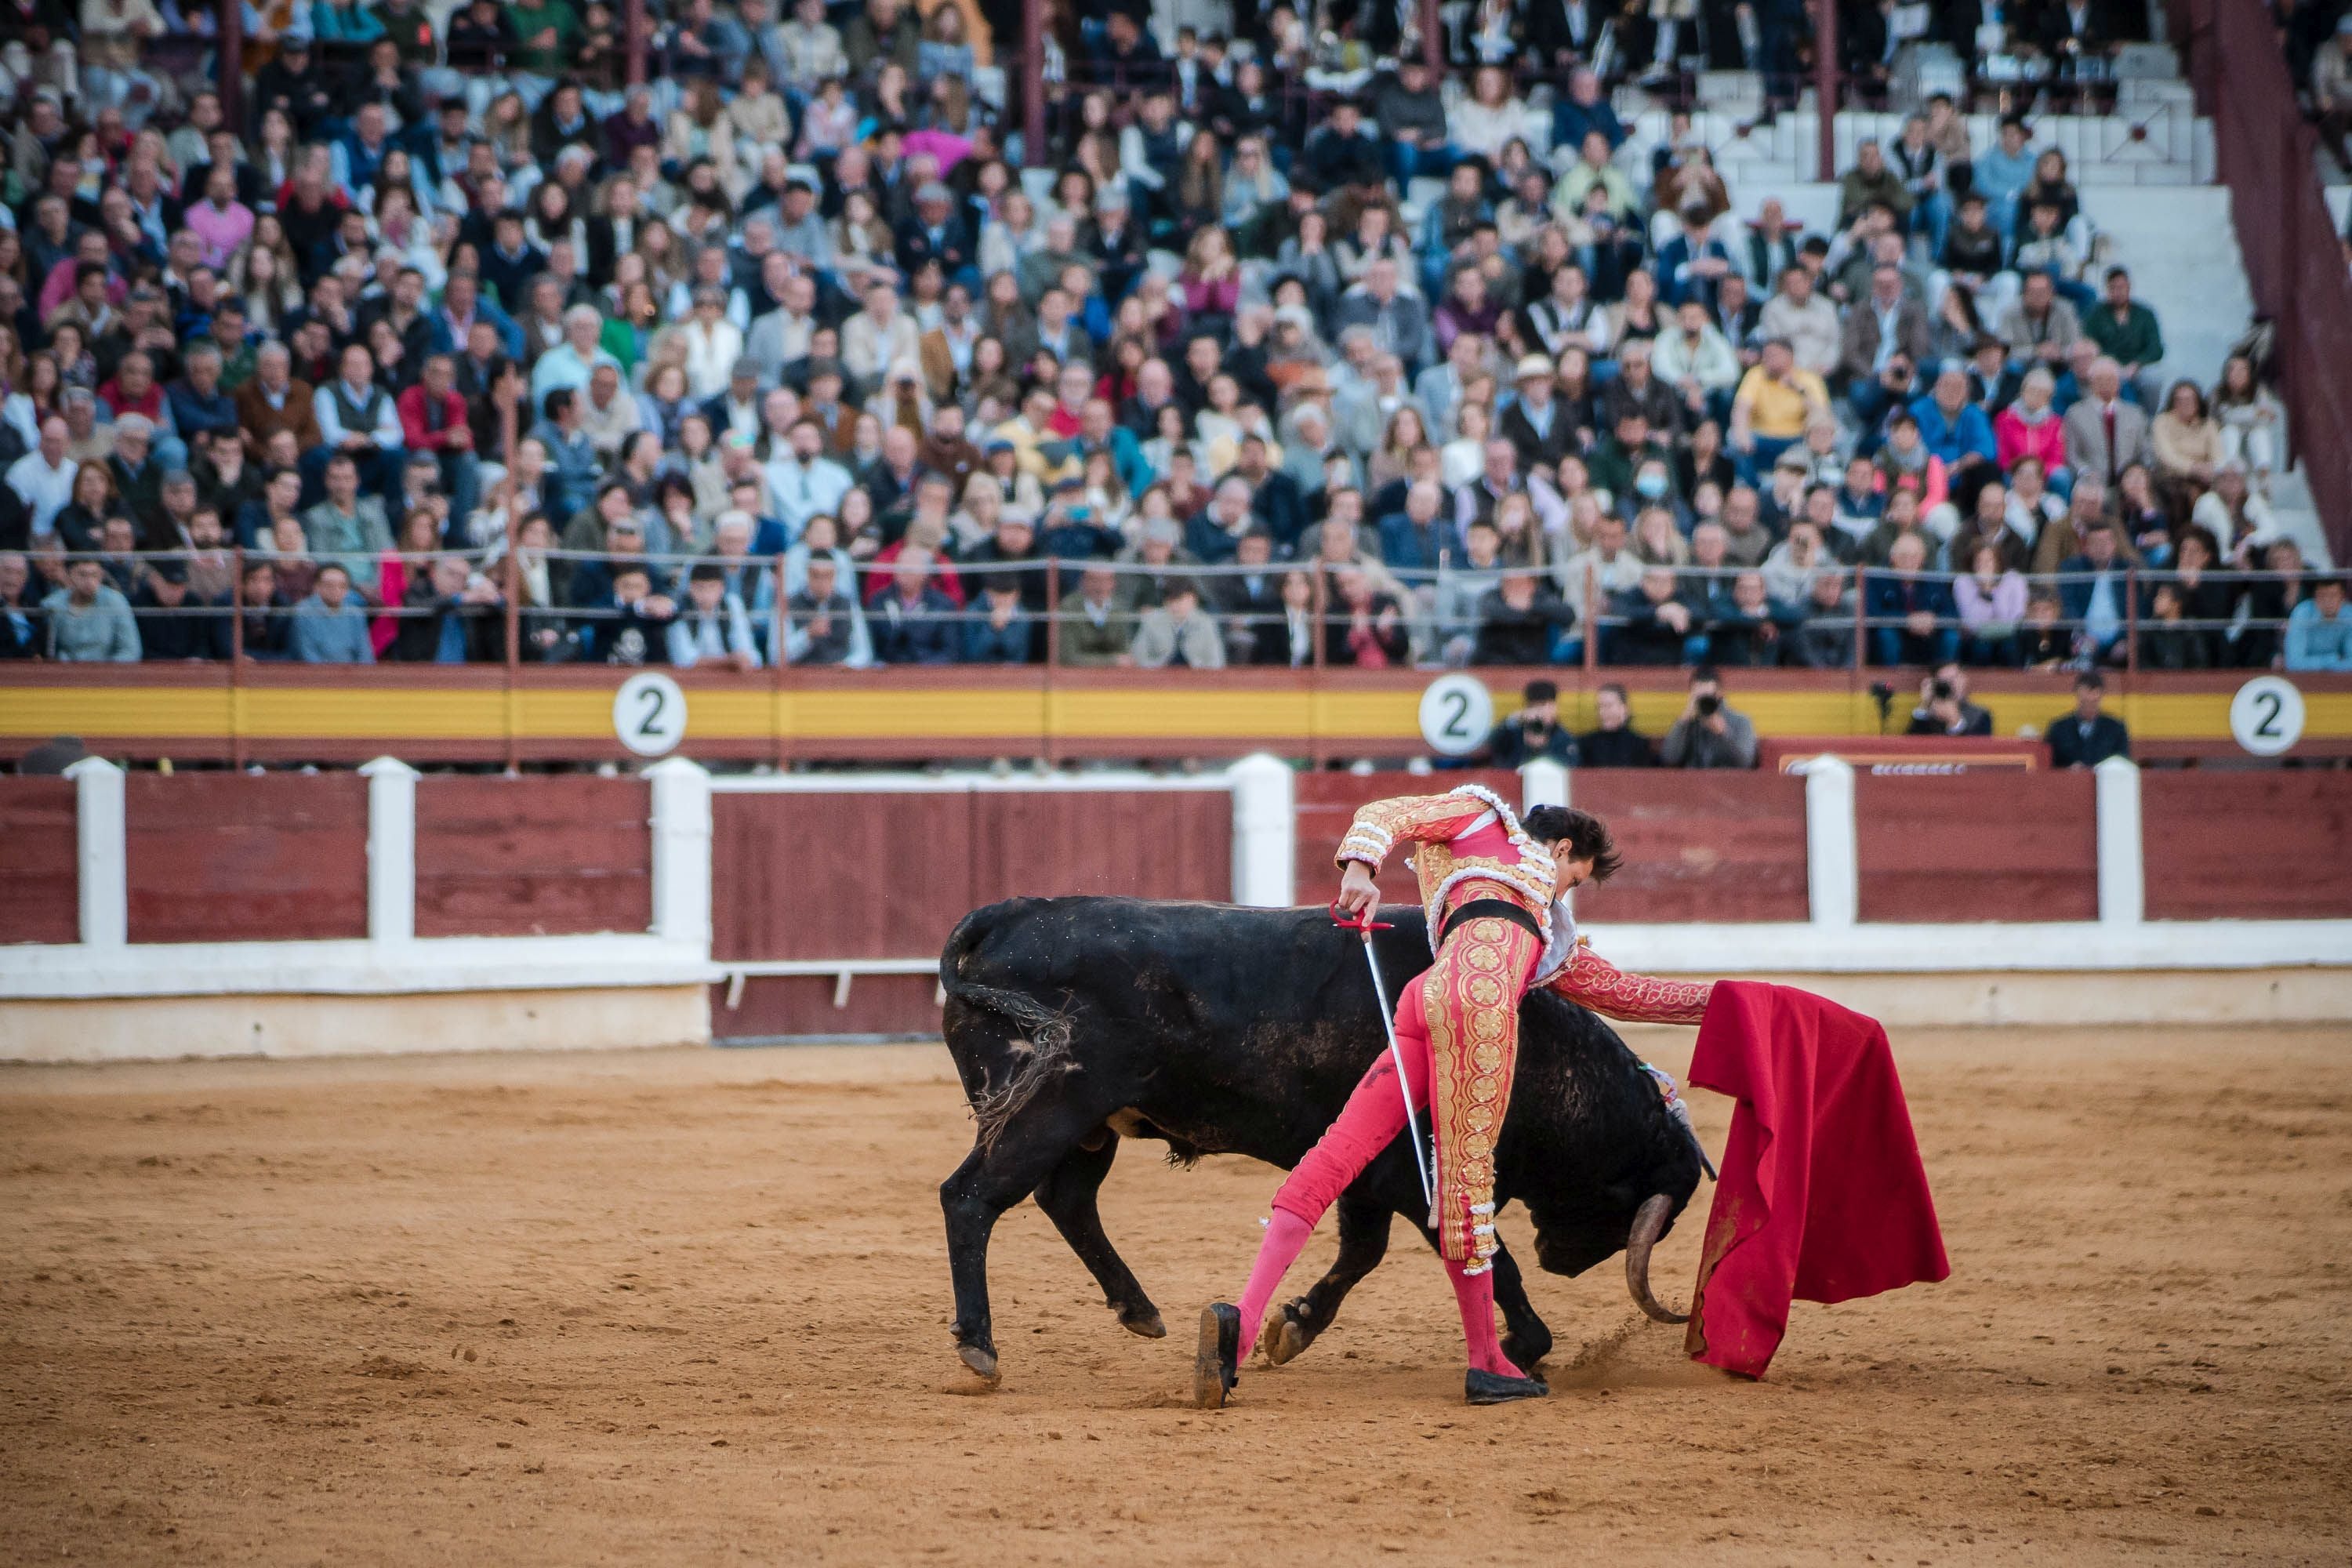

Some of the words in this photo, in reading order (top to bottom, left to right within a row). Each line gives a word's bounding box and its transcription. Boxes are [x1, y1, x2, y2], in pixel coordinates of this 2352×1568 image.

[638, 687, 665, 735] 2
[1442, 690, 1468, 737] 2
[2255, 690, 2283, 737] 2
